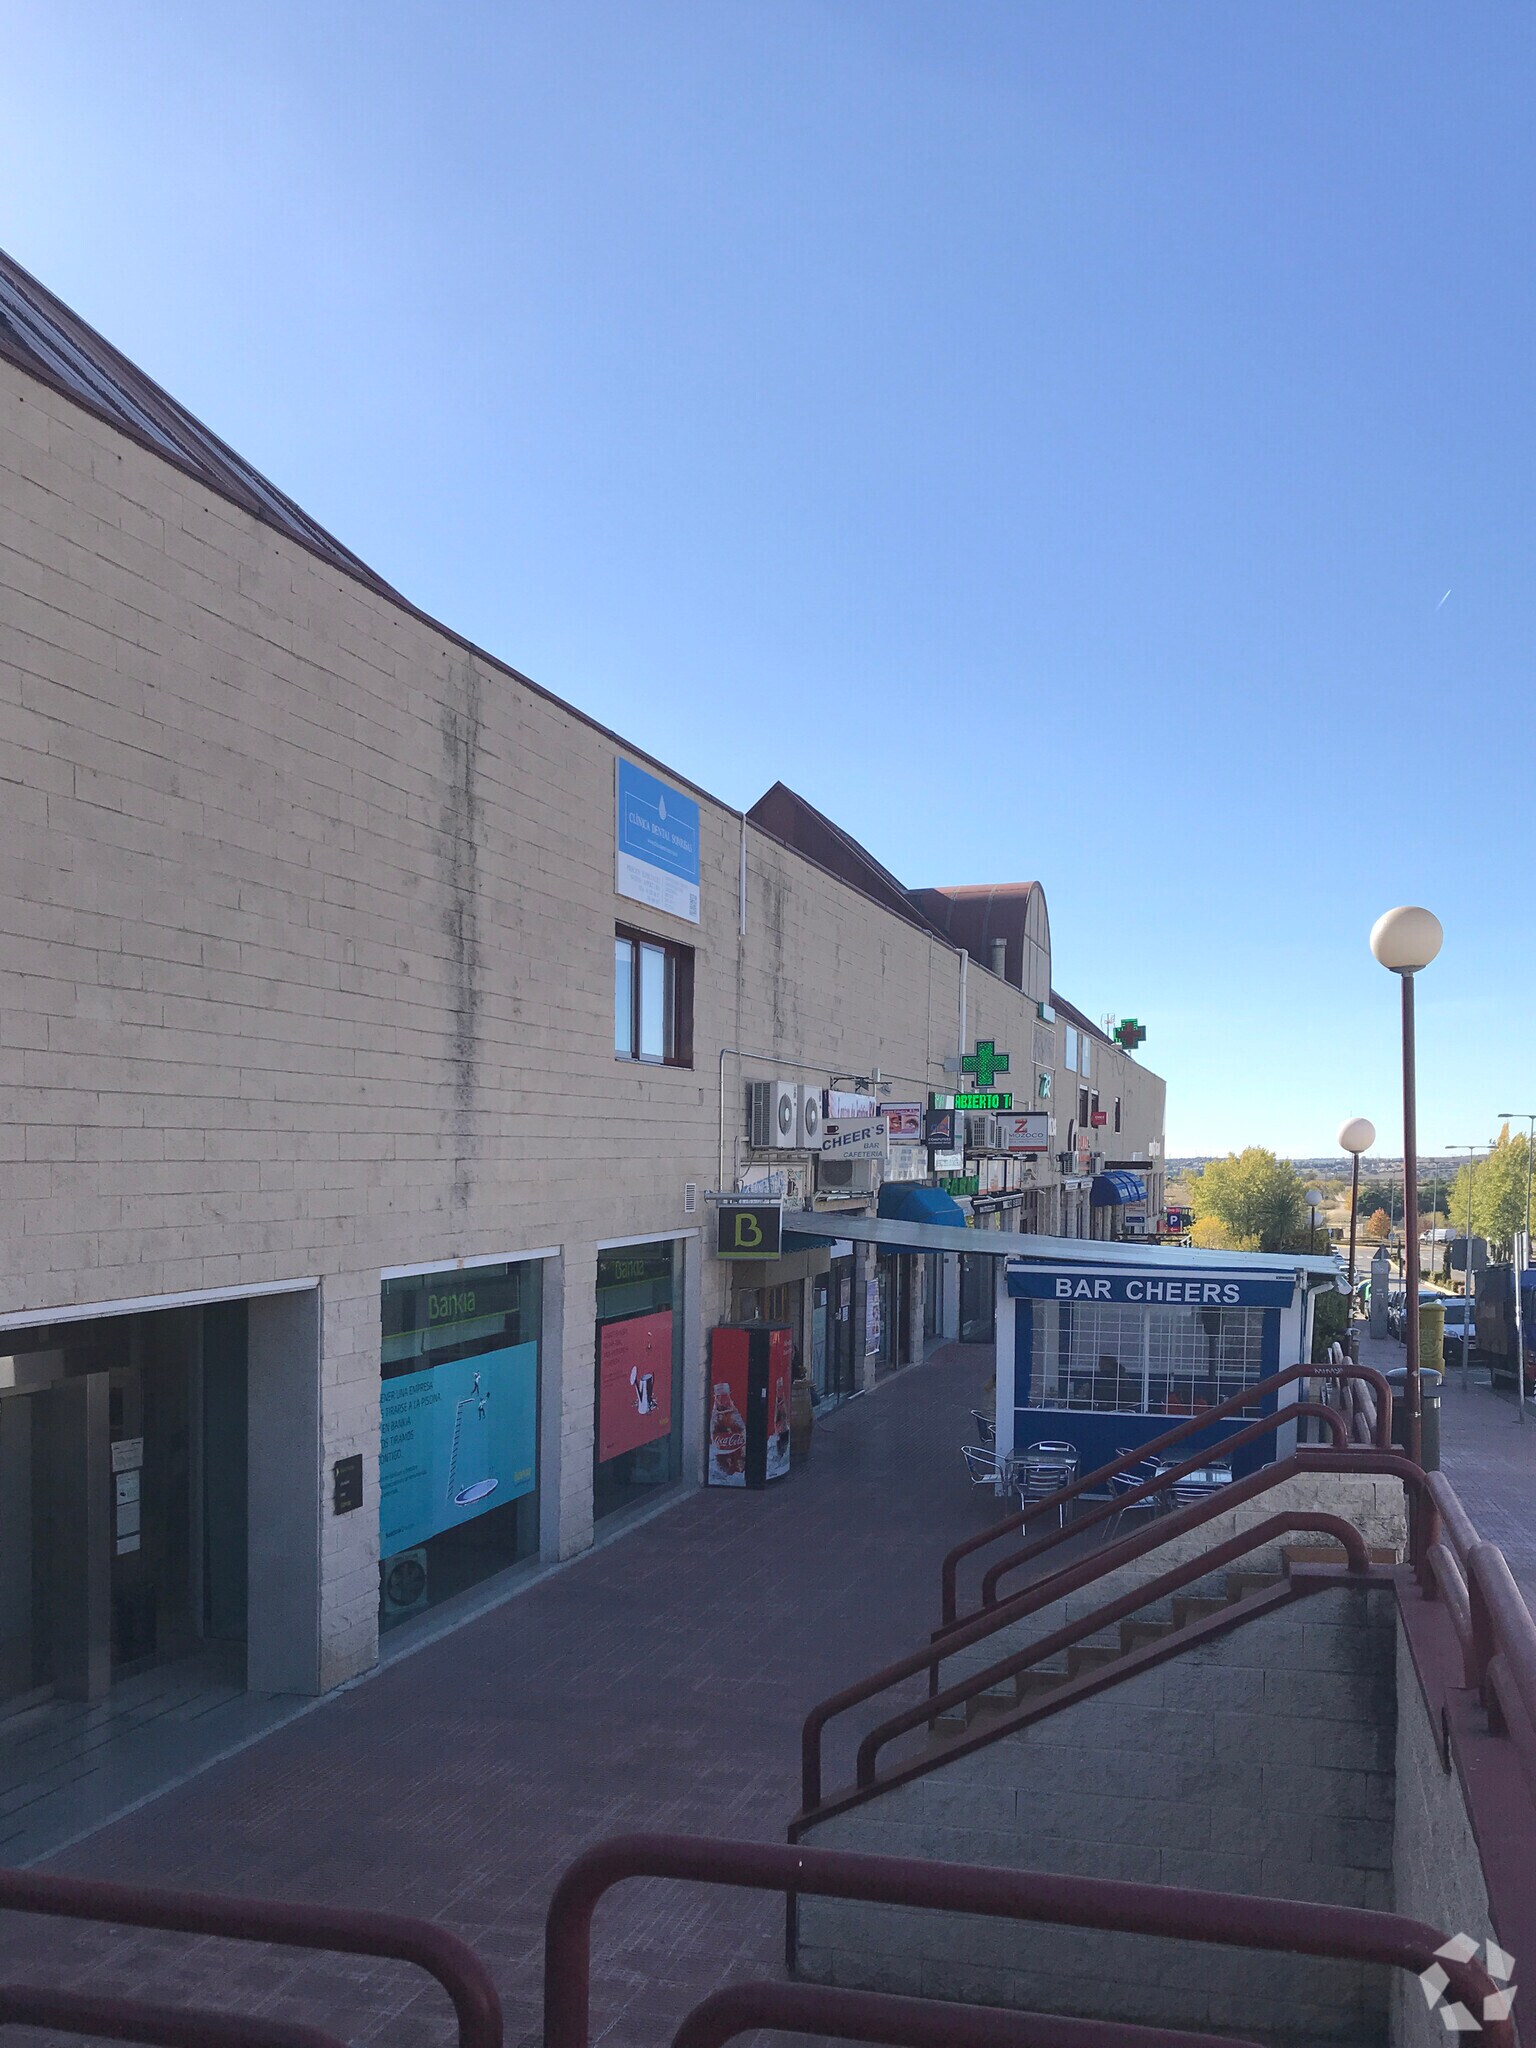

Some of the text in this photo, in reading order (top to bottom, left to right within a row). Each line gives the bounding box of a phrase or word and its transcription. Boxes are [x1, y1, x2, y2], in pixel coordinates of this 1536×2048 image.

[955, 1094, 1000, 1109] ABIERTO
[1014, 1119, 1028, 1133] Z
[1170, 1215, 1178, 1225] P
[735, 1213, 763, 1247] B
[615, 1260, 645, 1280] Bankia
[1055, 1278, 1241, 1303] BAR CHEERS
[428, 1291, 476, 1320] Bankia
[409, 1381, 434, 1396] EMPRESA
